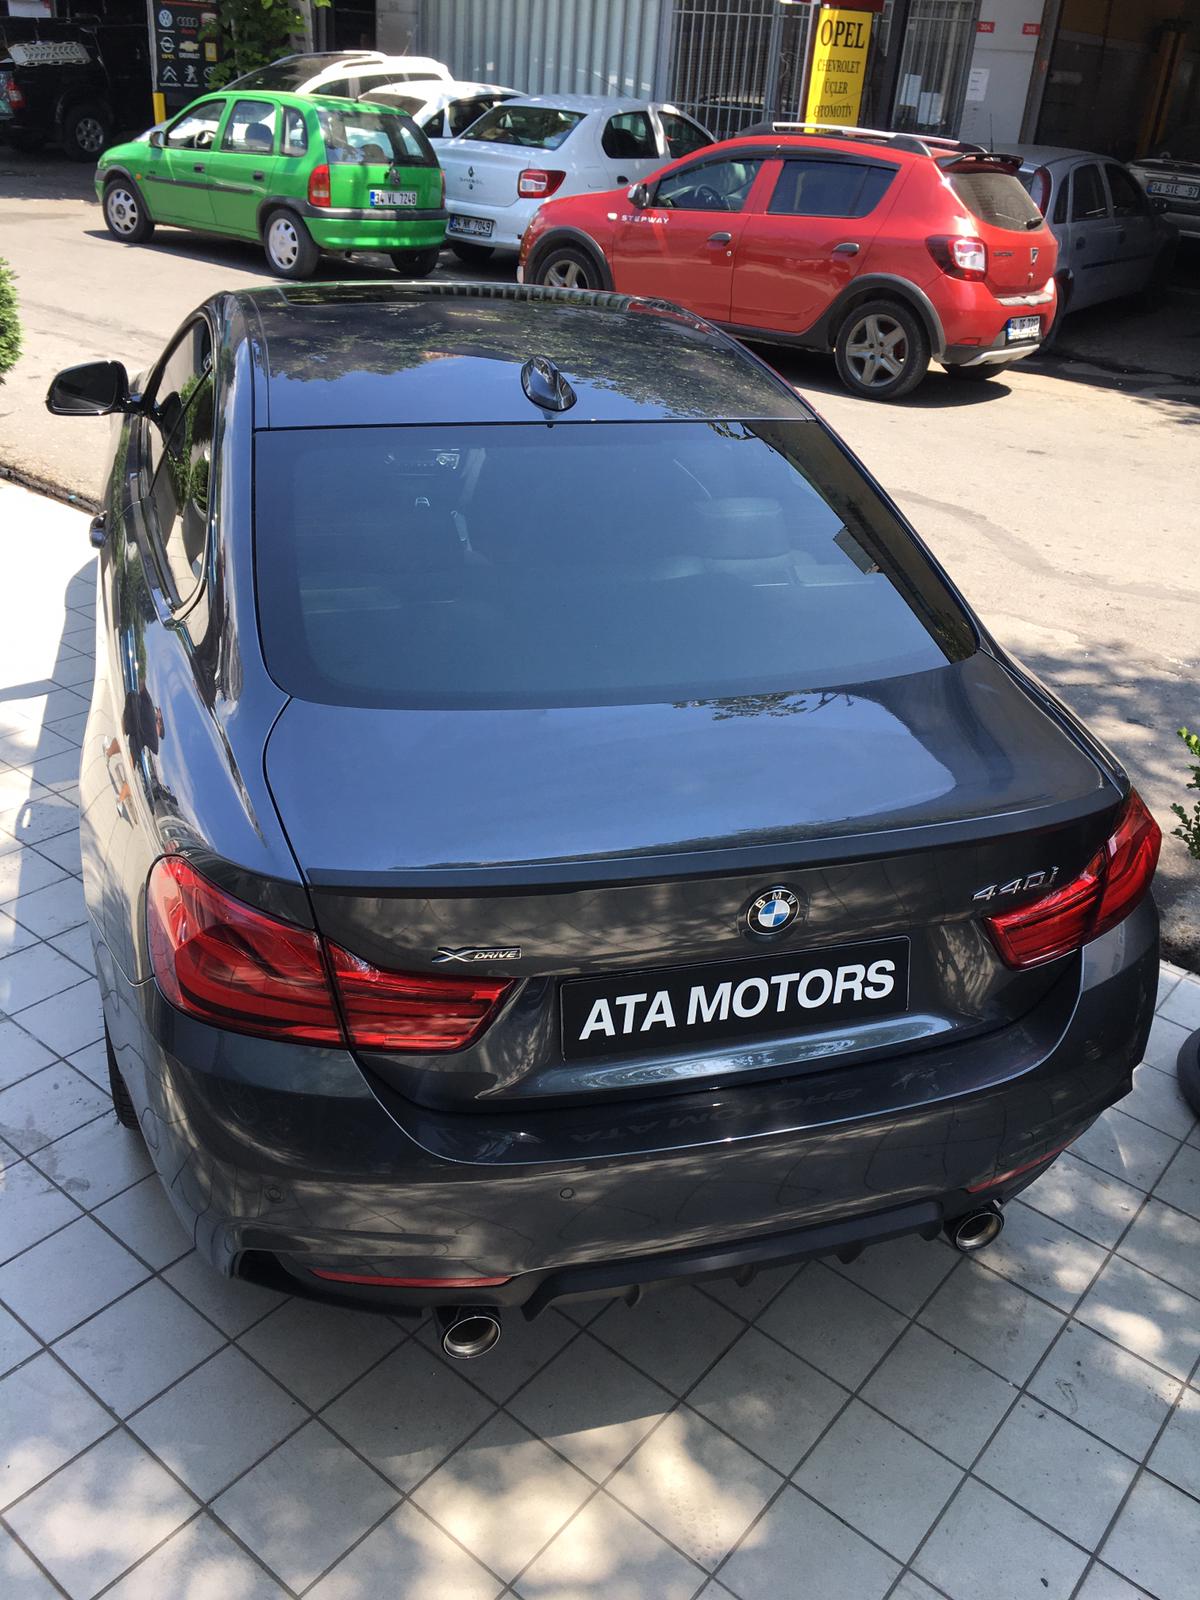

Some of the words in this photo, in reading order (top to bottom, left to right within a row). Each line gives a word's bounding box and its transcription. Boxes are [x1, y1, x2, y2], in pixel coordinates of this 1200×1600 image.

[821, 19, 866, 49] OPEL
[817, 59, 861, 74] CHEVROLET
[824, 79, 849, 97] ÜÇLER
[375, 192, 385, 204] 34
[388, 193, 397, 204] VL
[621, 214, 670, 224] STEPWAY
[971, 865, 1060, 901] 440i
[755, 891, 797, 909] BMW
[578, 991, 677, 1041] ATA
[686, 959, 897, 1026] MOTORS
